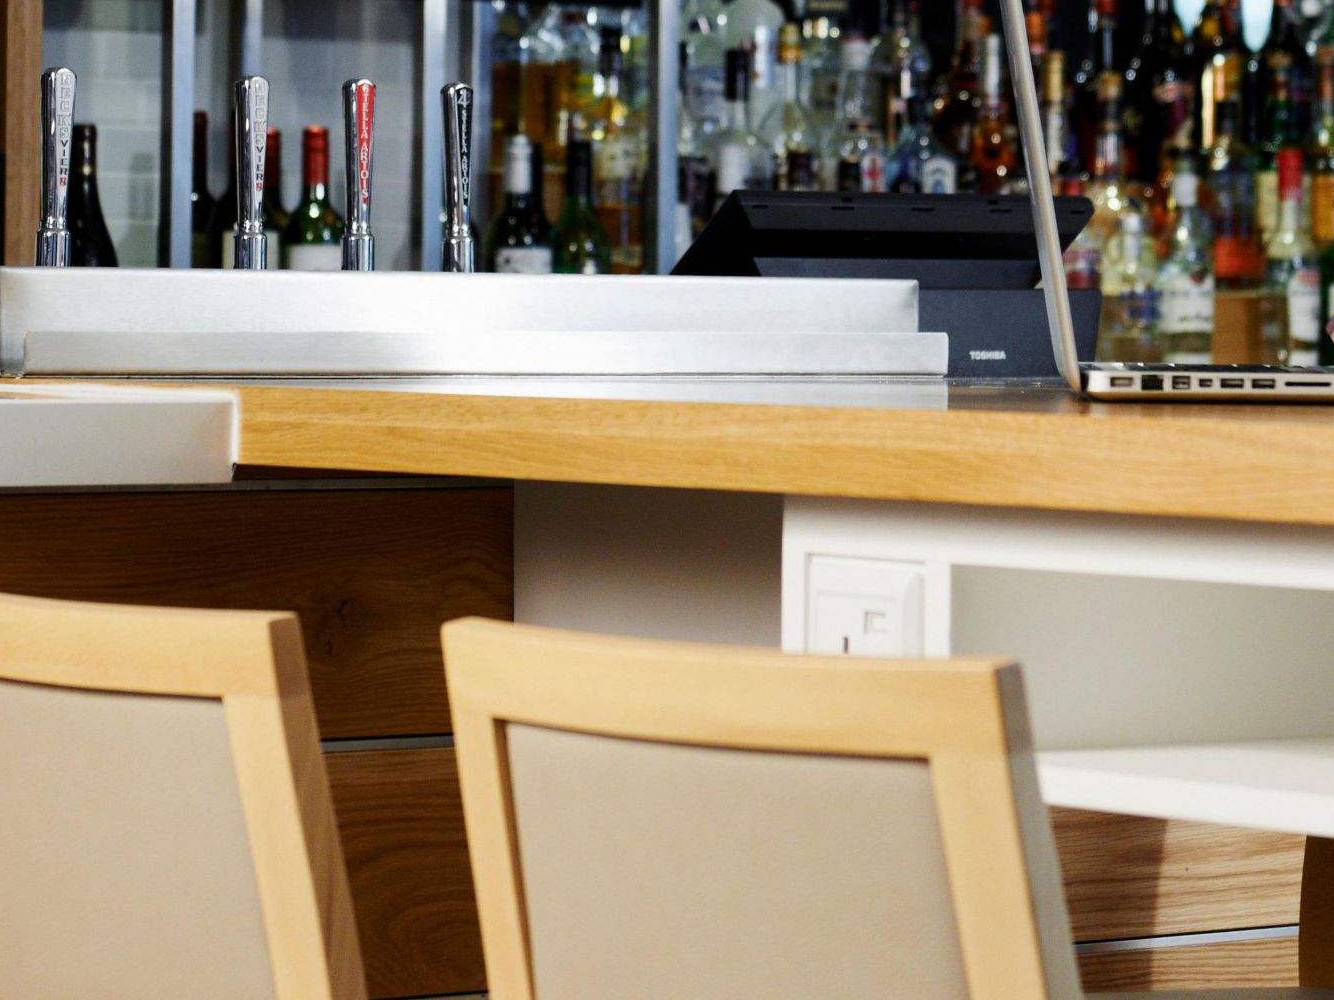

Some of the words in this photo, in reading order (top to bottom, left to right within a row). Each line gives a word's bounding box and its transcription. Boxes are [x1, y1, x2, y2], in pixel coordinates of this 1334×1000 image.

[361, 84, 370, 138] STELLA
[59, 140, 69, 176] VIER
[360, 143, 369, 198] ARTOIS
[969, 350, 1007, 360] TOSHIBA
